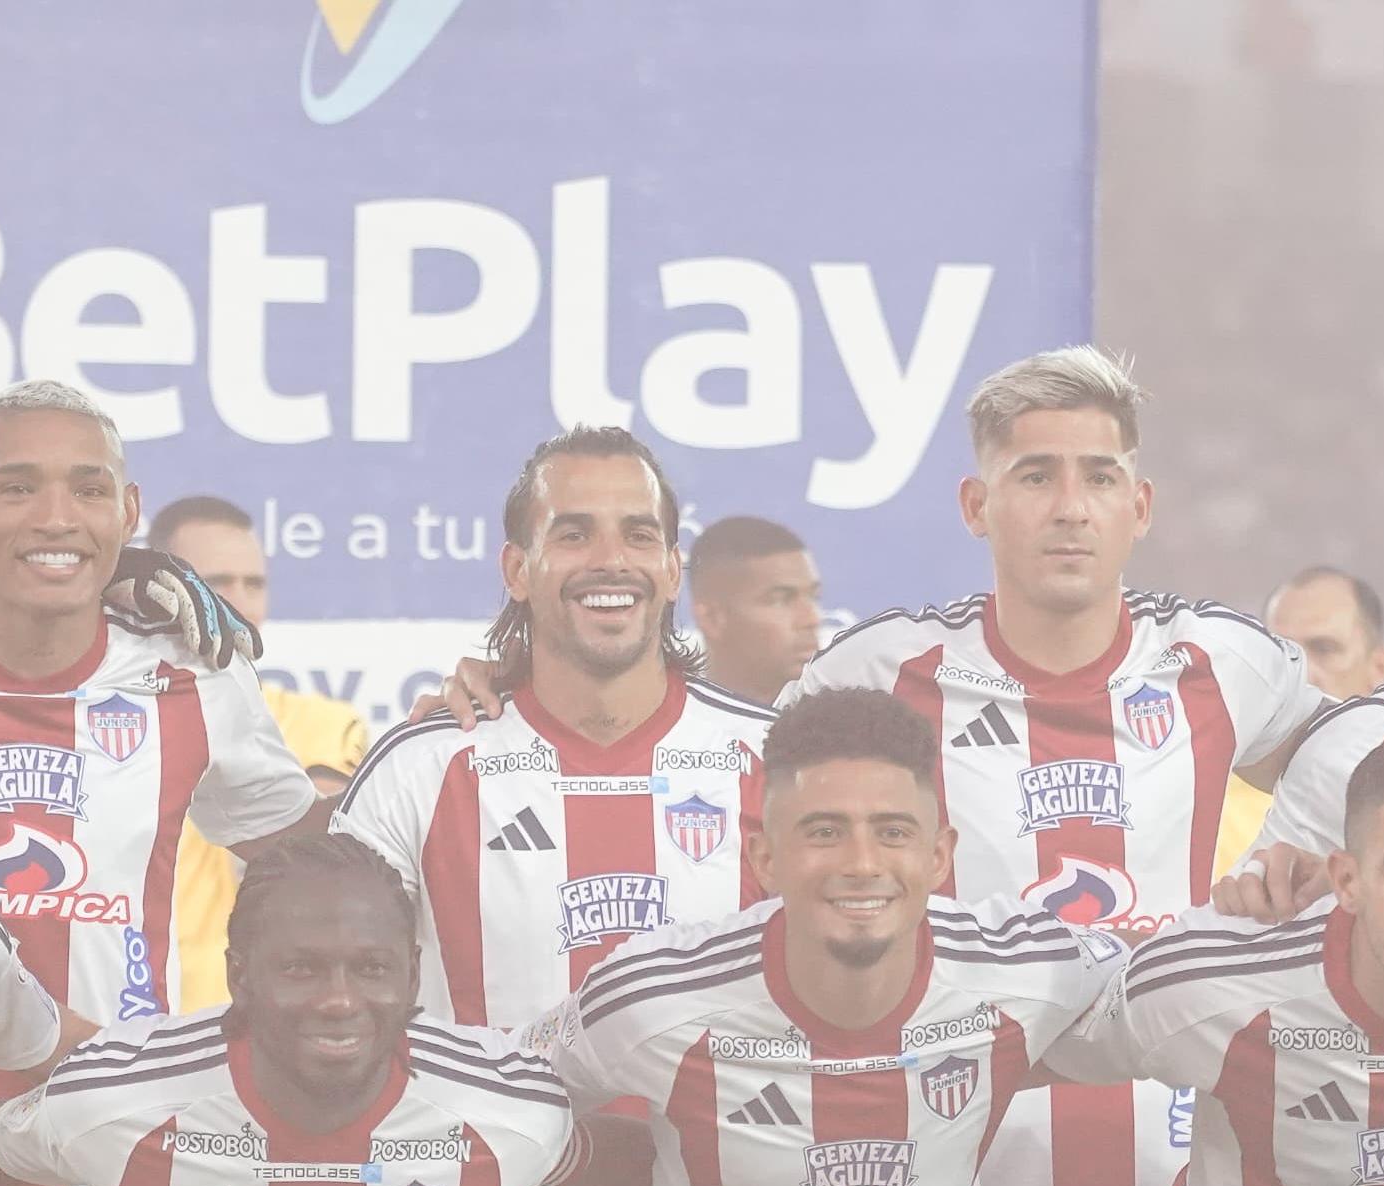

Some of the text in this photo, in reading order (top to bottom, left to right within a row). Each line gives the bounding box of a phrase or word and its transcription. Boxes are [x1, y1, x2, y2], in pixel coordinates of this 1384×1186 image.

[1130, 704, 1167, 718] JUNIOR
[94, 717, 139, 730] JUNIOR
[1029, 786, 1118, 821] AGUILA
[673, 817, 718, 829] JUNIOR
[570, 901, 659, 936] AGUILA
[930, 1074, 972, 1092] JUNIOR
